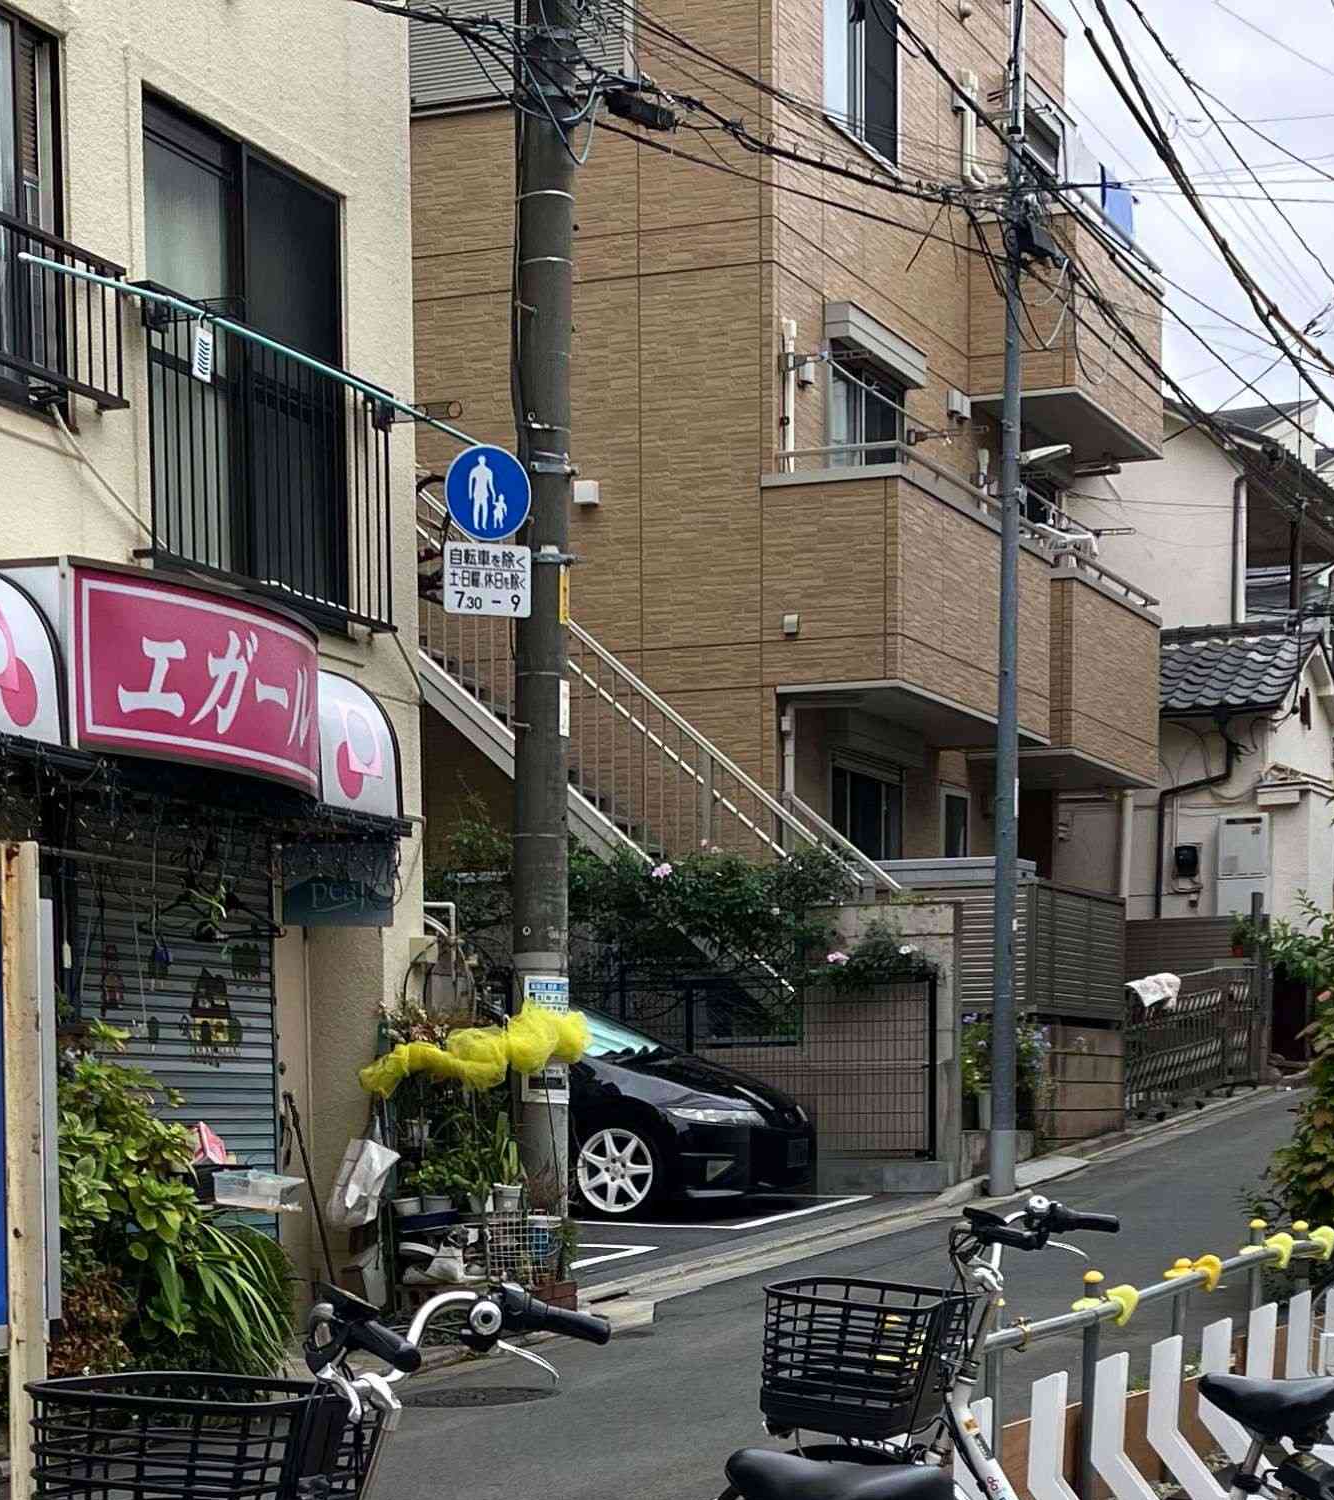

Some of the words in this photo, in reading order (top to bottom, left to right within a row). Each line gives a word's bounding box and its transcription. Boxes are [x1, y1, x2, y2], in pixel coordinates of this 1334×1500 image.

[449, 546, 526, 569] 自転車を除く
[511, 594, 521, 612] 9
[118, 630, 313, 748] エガール
